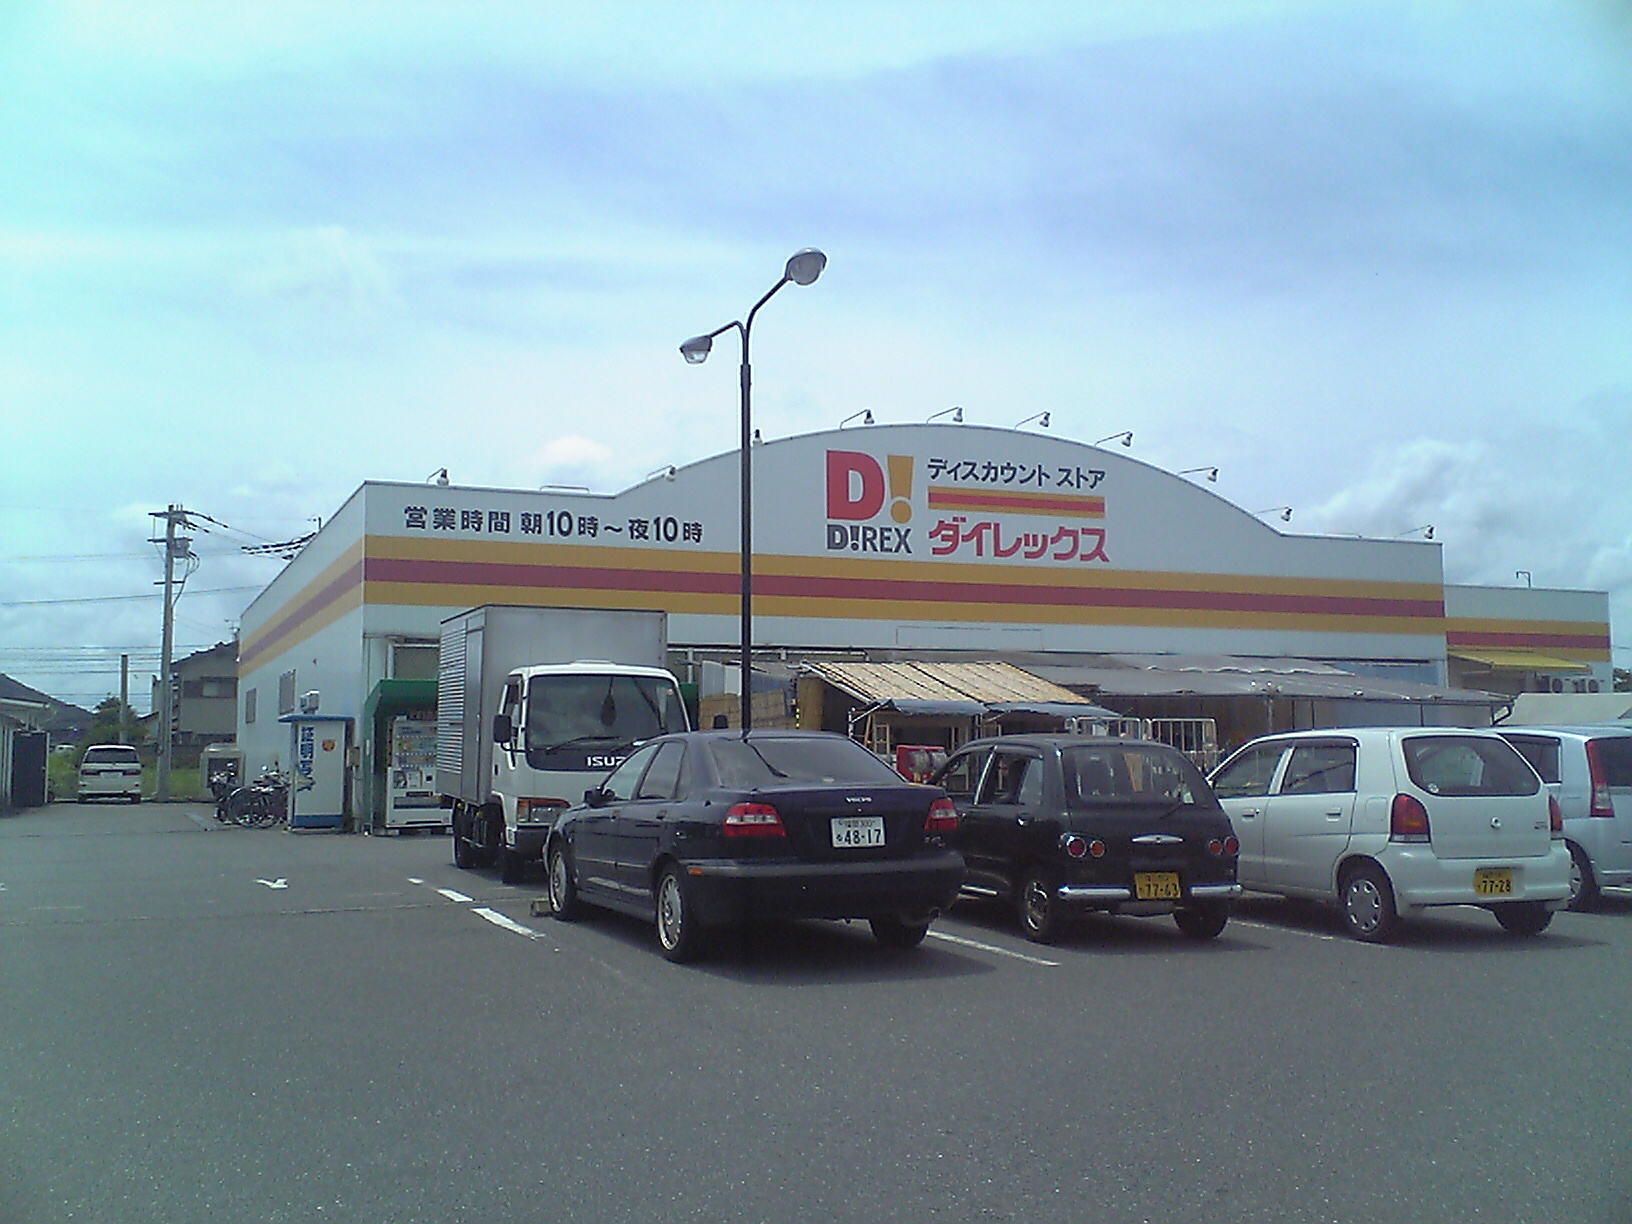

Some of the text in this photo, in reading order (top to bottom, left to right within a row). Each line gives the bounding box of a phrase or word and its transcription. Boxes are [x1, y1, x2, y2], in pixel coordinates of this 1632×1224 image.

[927, 458, 1106, 489] ディスカウント ストア
[403, 505, 511, 535] 営業時間
[928, 515, 1110, 563] ダイレックス
[587, 755, 626, 767] ISUZ
